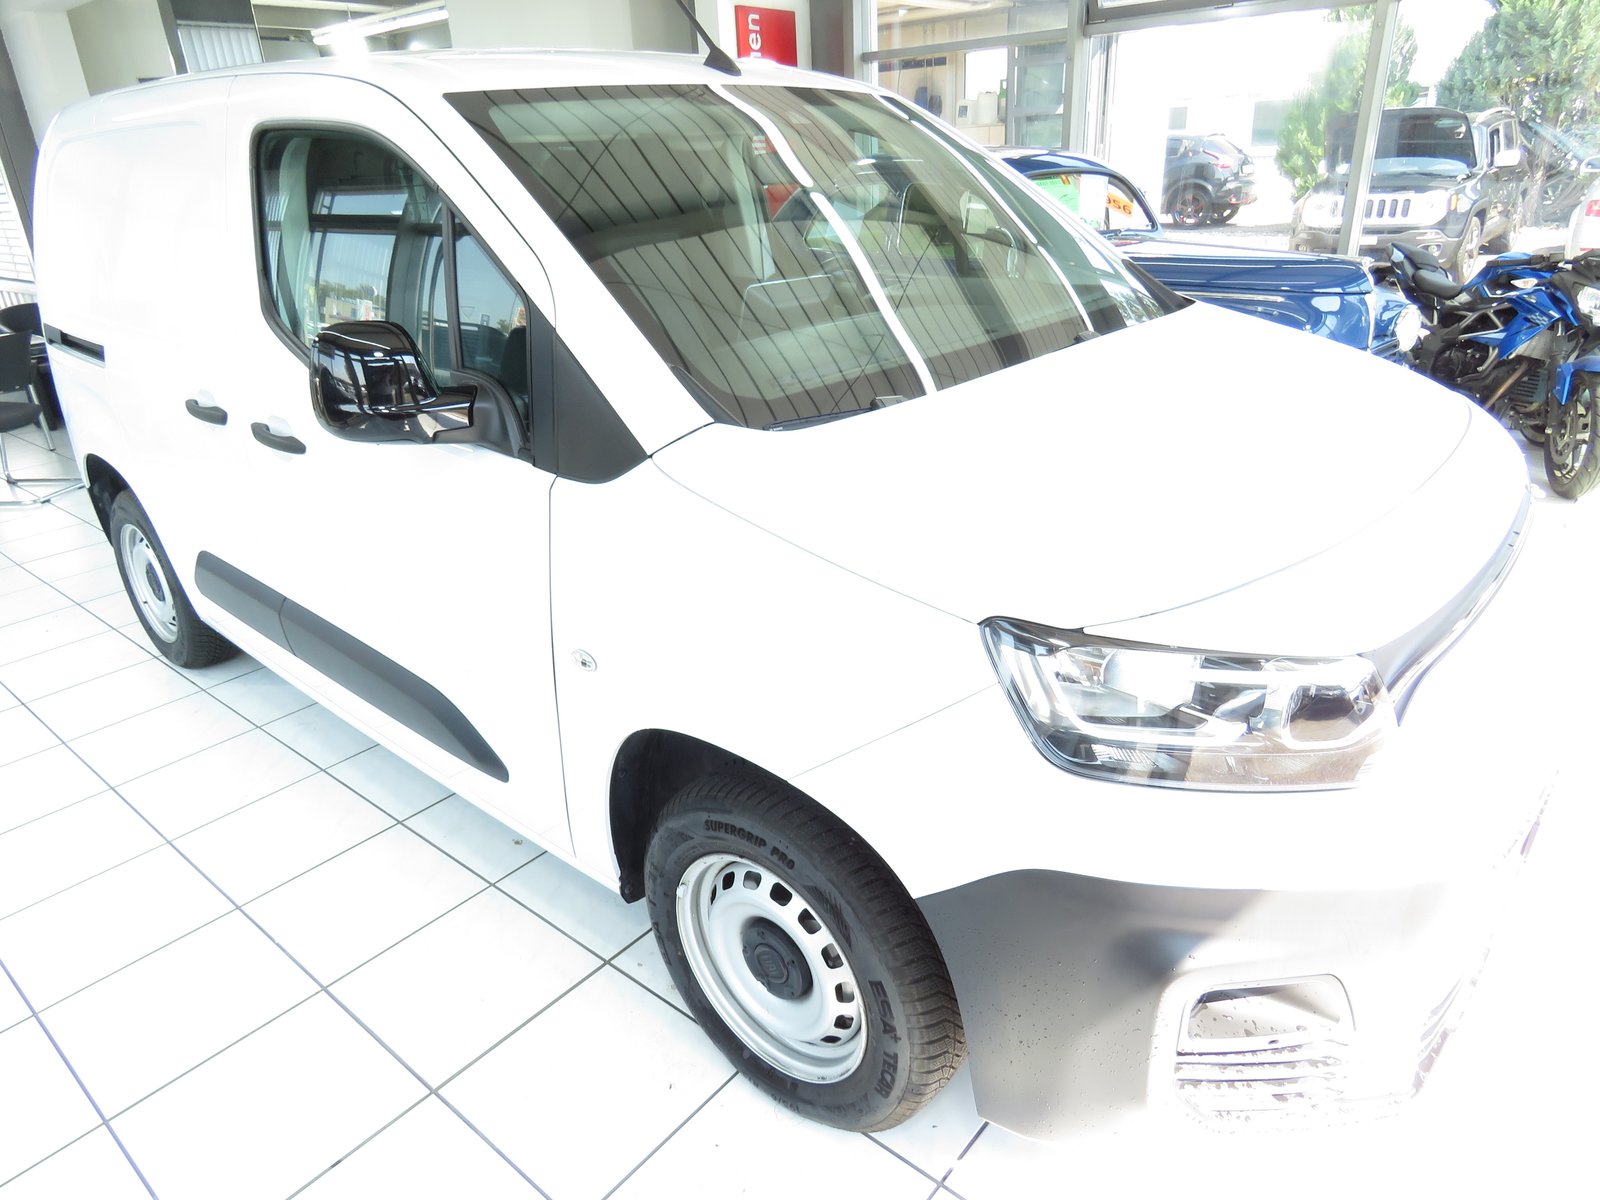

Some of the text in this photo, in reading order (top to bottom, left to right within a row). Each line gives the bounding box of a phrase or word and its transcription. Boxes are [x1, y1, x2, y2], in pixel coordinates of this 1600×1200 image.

[704, 819, 795, 870] SUPERGRIP PRO
[874, 1051, 898, 1099] TECAR
